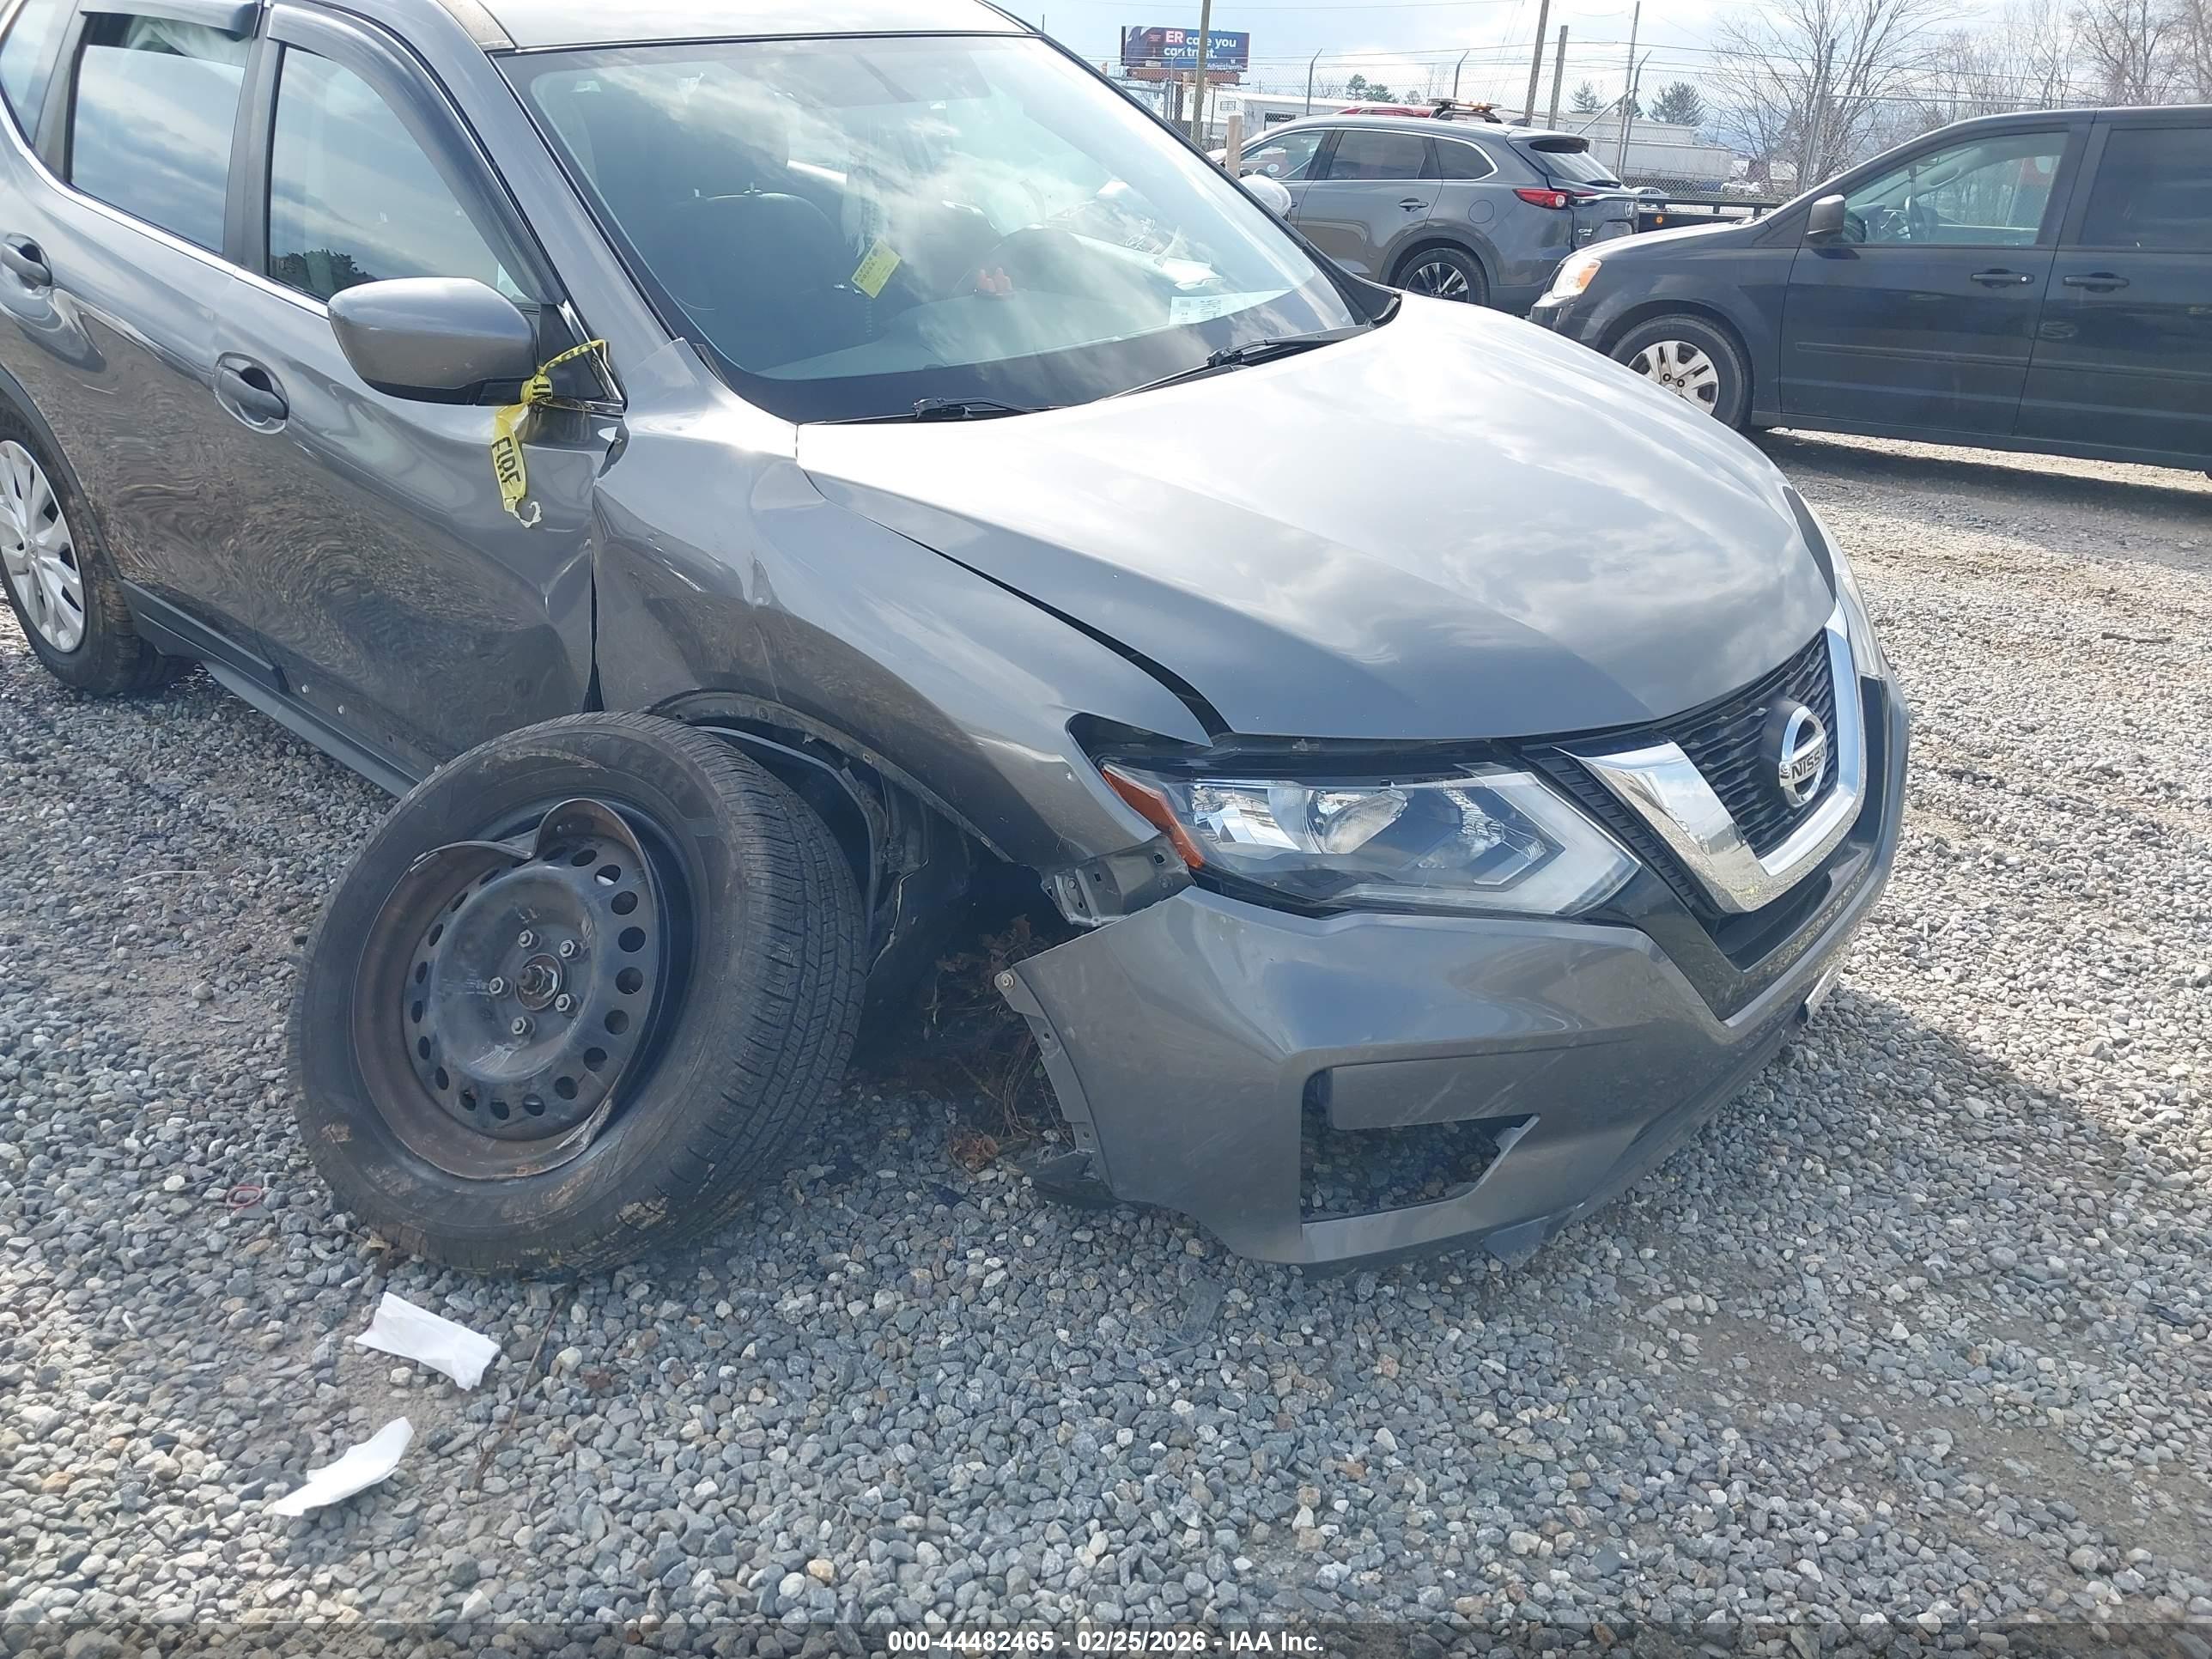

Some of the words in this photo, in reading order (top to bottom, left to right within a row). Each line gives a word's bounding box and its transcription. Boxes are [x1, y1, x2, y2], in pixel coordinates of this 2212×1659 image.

[1165, 30, 1184, 43] ER
[1186, 36, 1212, 46] cae
[1215, 37, 1237, 50] you
[1164, 46, 1185, 57] can
[1187, 45, 1218, 58] trst.
